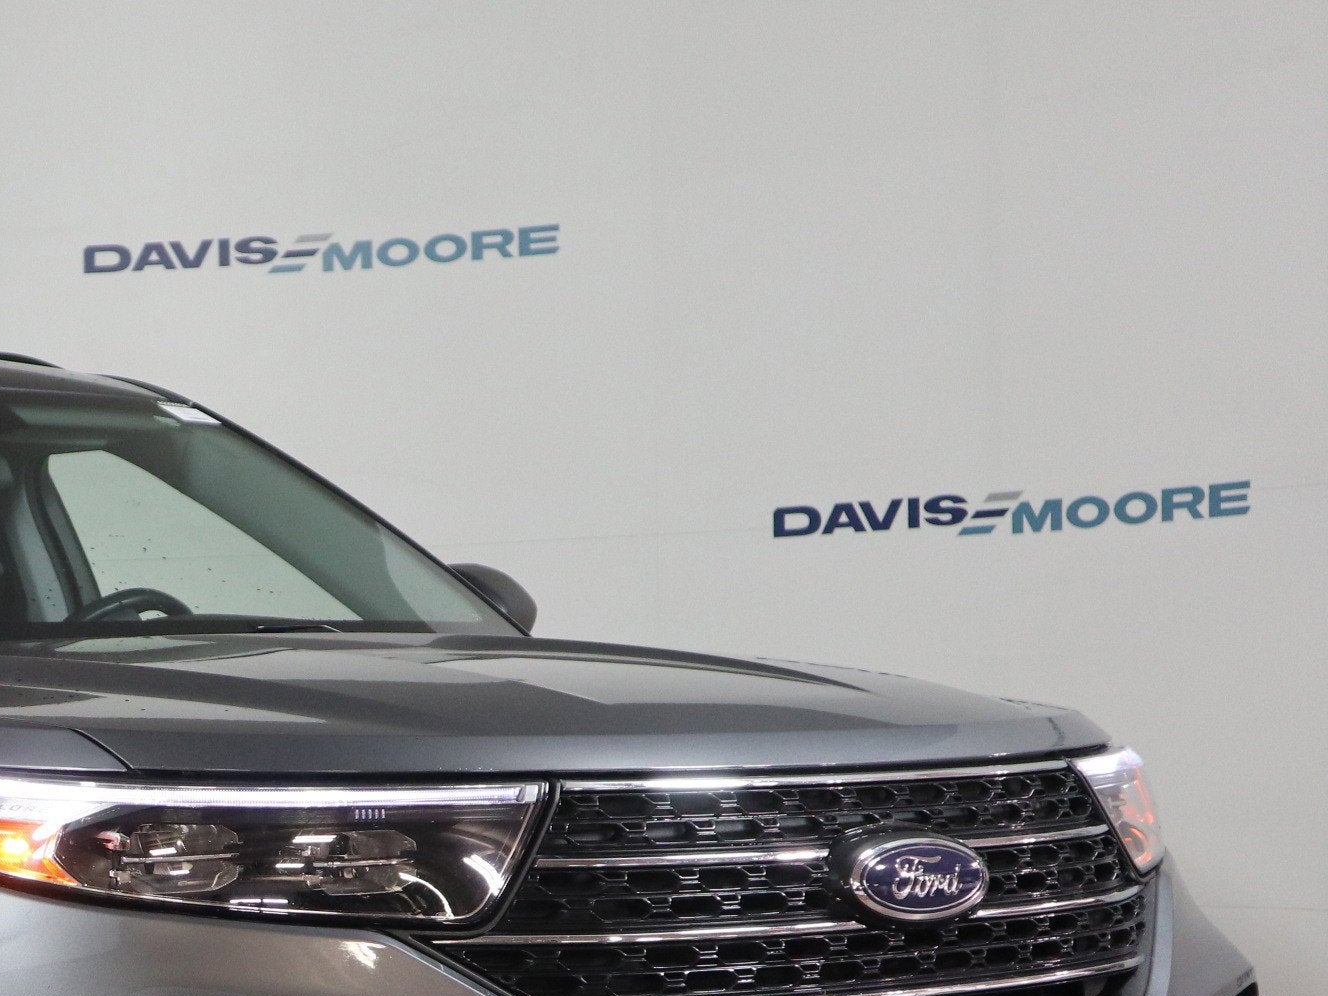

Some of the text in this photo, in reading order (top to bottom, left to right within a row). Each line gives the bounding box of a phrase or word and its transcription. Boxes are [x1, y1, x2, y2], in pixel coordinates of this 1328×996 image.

[83, 223, 561, 274] DAVIS MOORE
[773, 480, 1252, 538] DAVIS MOORE
[891, 854, 963, 900] Ford
